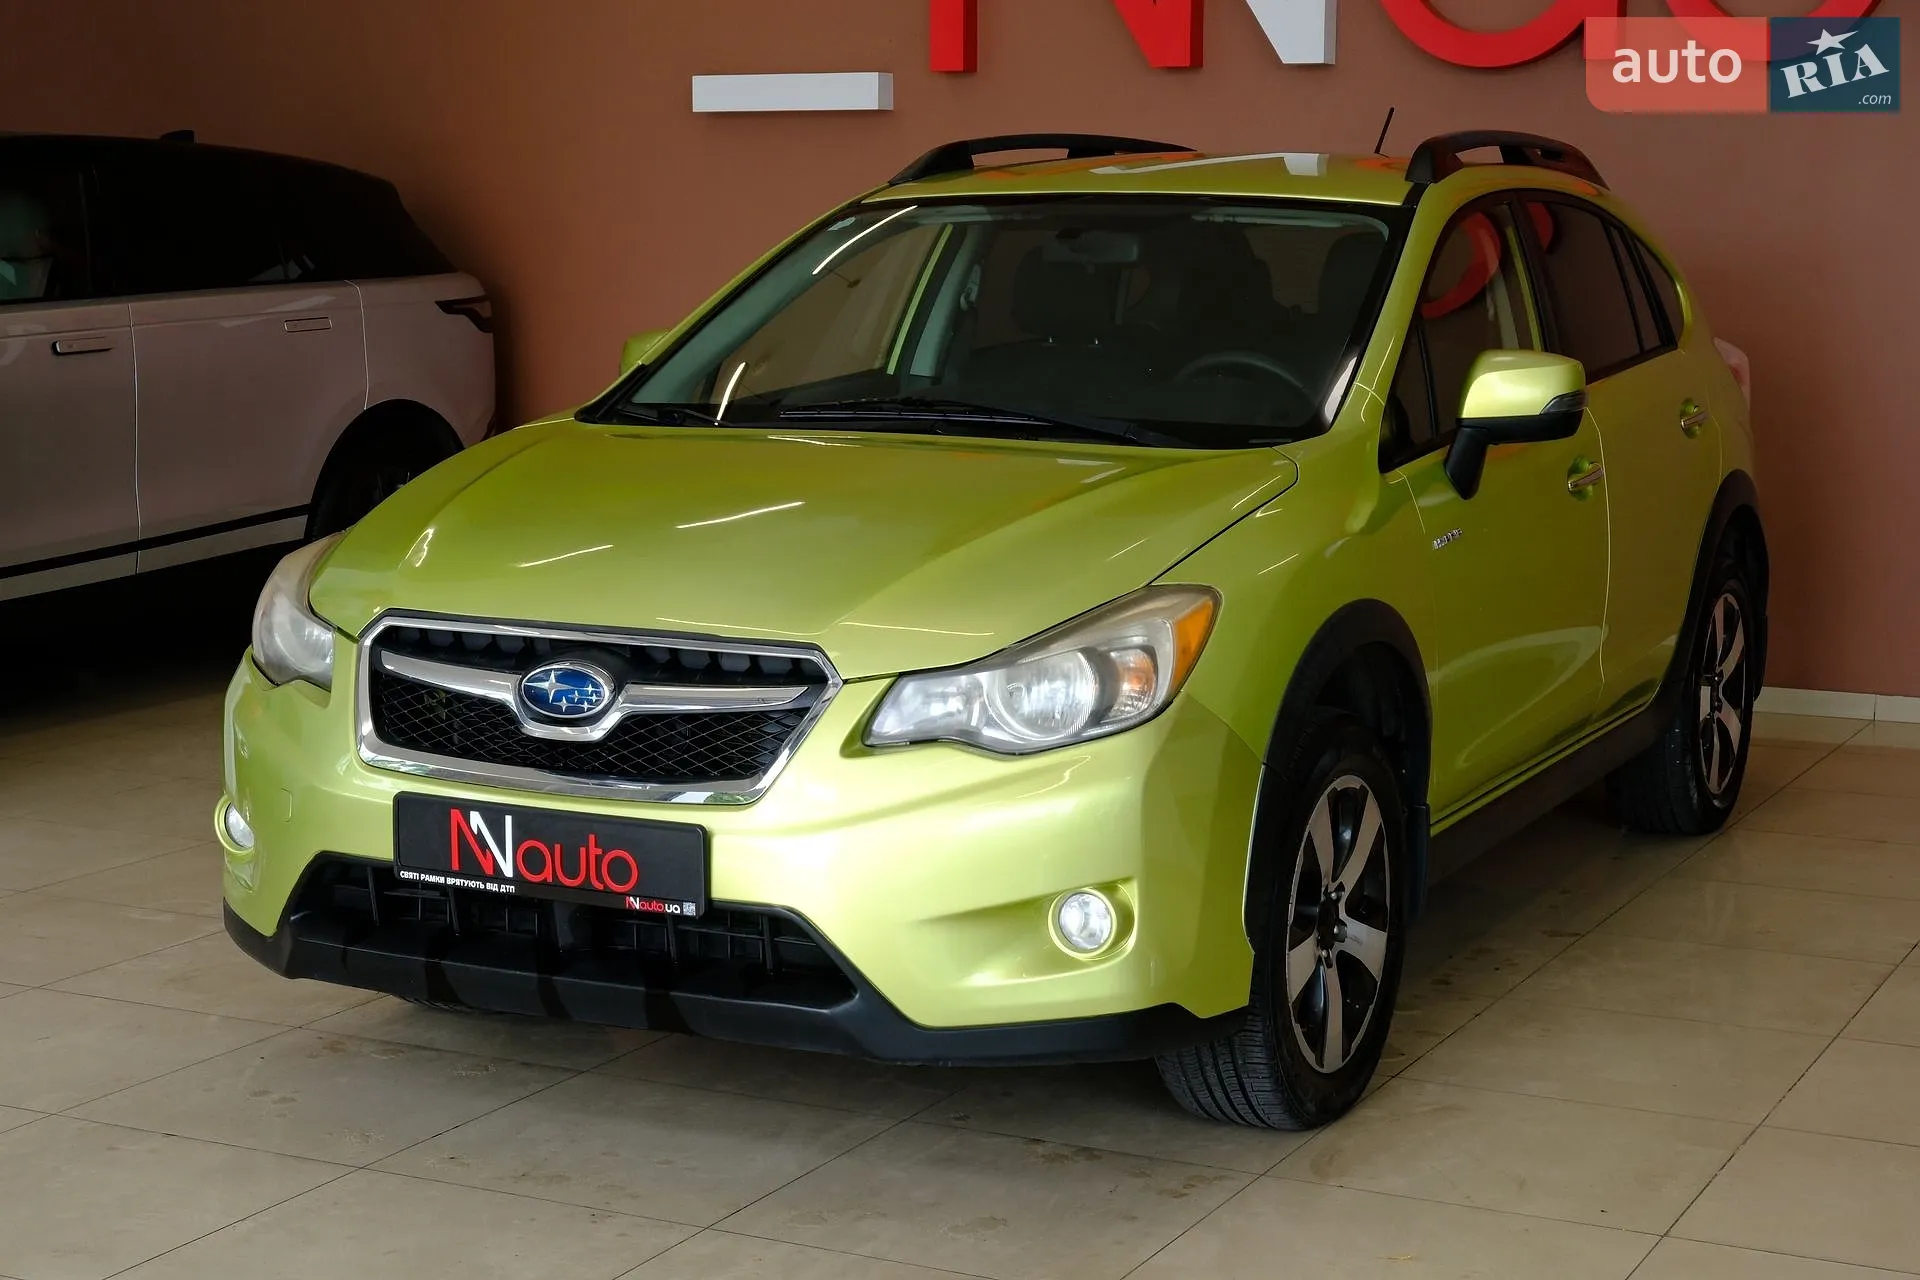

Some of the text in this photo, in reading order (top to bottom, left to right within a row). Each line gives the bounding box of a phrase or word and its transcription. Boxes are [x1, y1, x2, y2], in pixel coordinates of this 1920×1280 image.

[400, 870, 515, 893] СВЯТІ РАМКИ ВРЯТУЮТЬ ВІД ДТП
